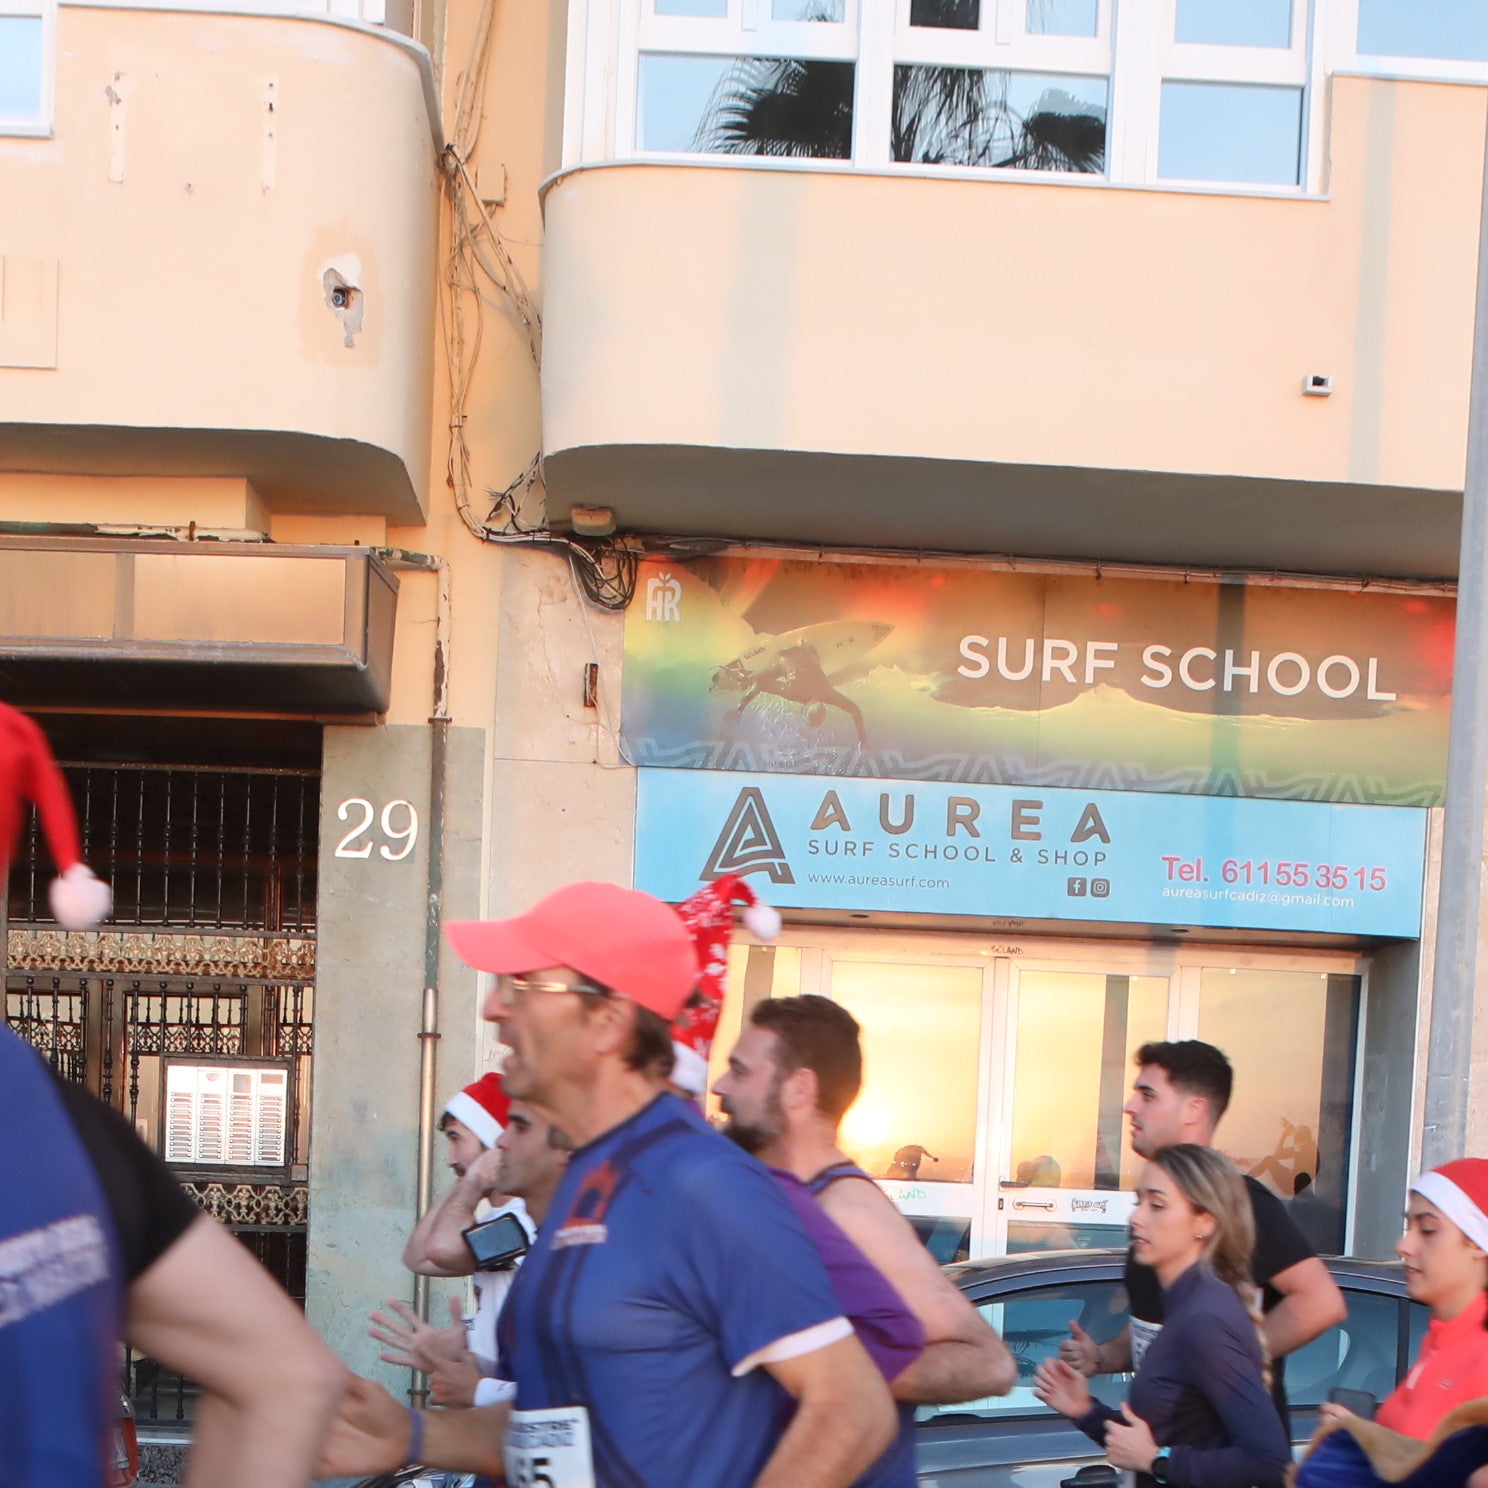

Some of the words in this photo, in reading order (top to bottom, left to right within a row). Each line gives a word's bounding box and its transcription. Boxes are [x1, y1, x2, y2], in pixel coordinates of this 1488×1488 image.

[957, 634, 1118, 684] SURF
[1140, 644, 1397, 701] SCHOOL
[335, 798, 419, 861] 29
[810, 789, 1111, 844] AUREA
[807, 839, 874, 857] SURF
[888, 843, 996, 863] SCHOOL
[1010, 848, 1024, 864] &
[1038, 849, 1107, 867] SHOP
[808, 871, 950, 889] www.aureasurf.com
[1161, 856, 1209, 883] Tel.
[1162, 886, 1354, 908] aureasurfcadiz@gmail.com
